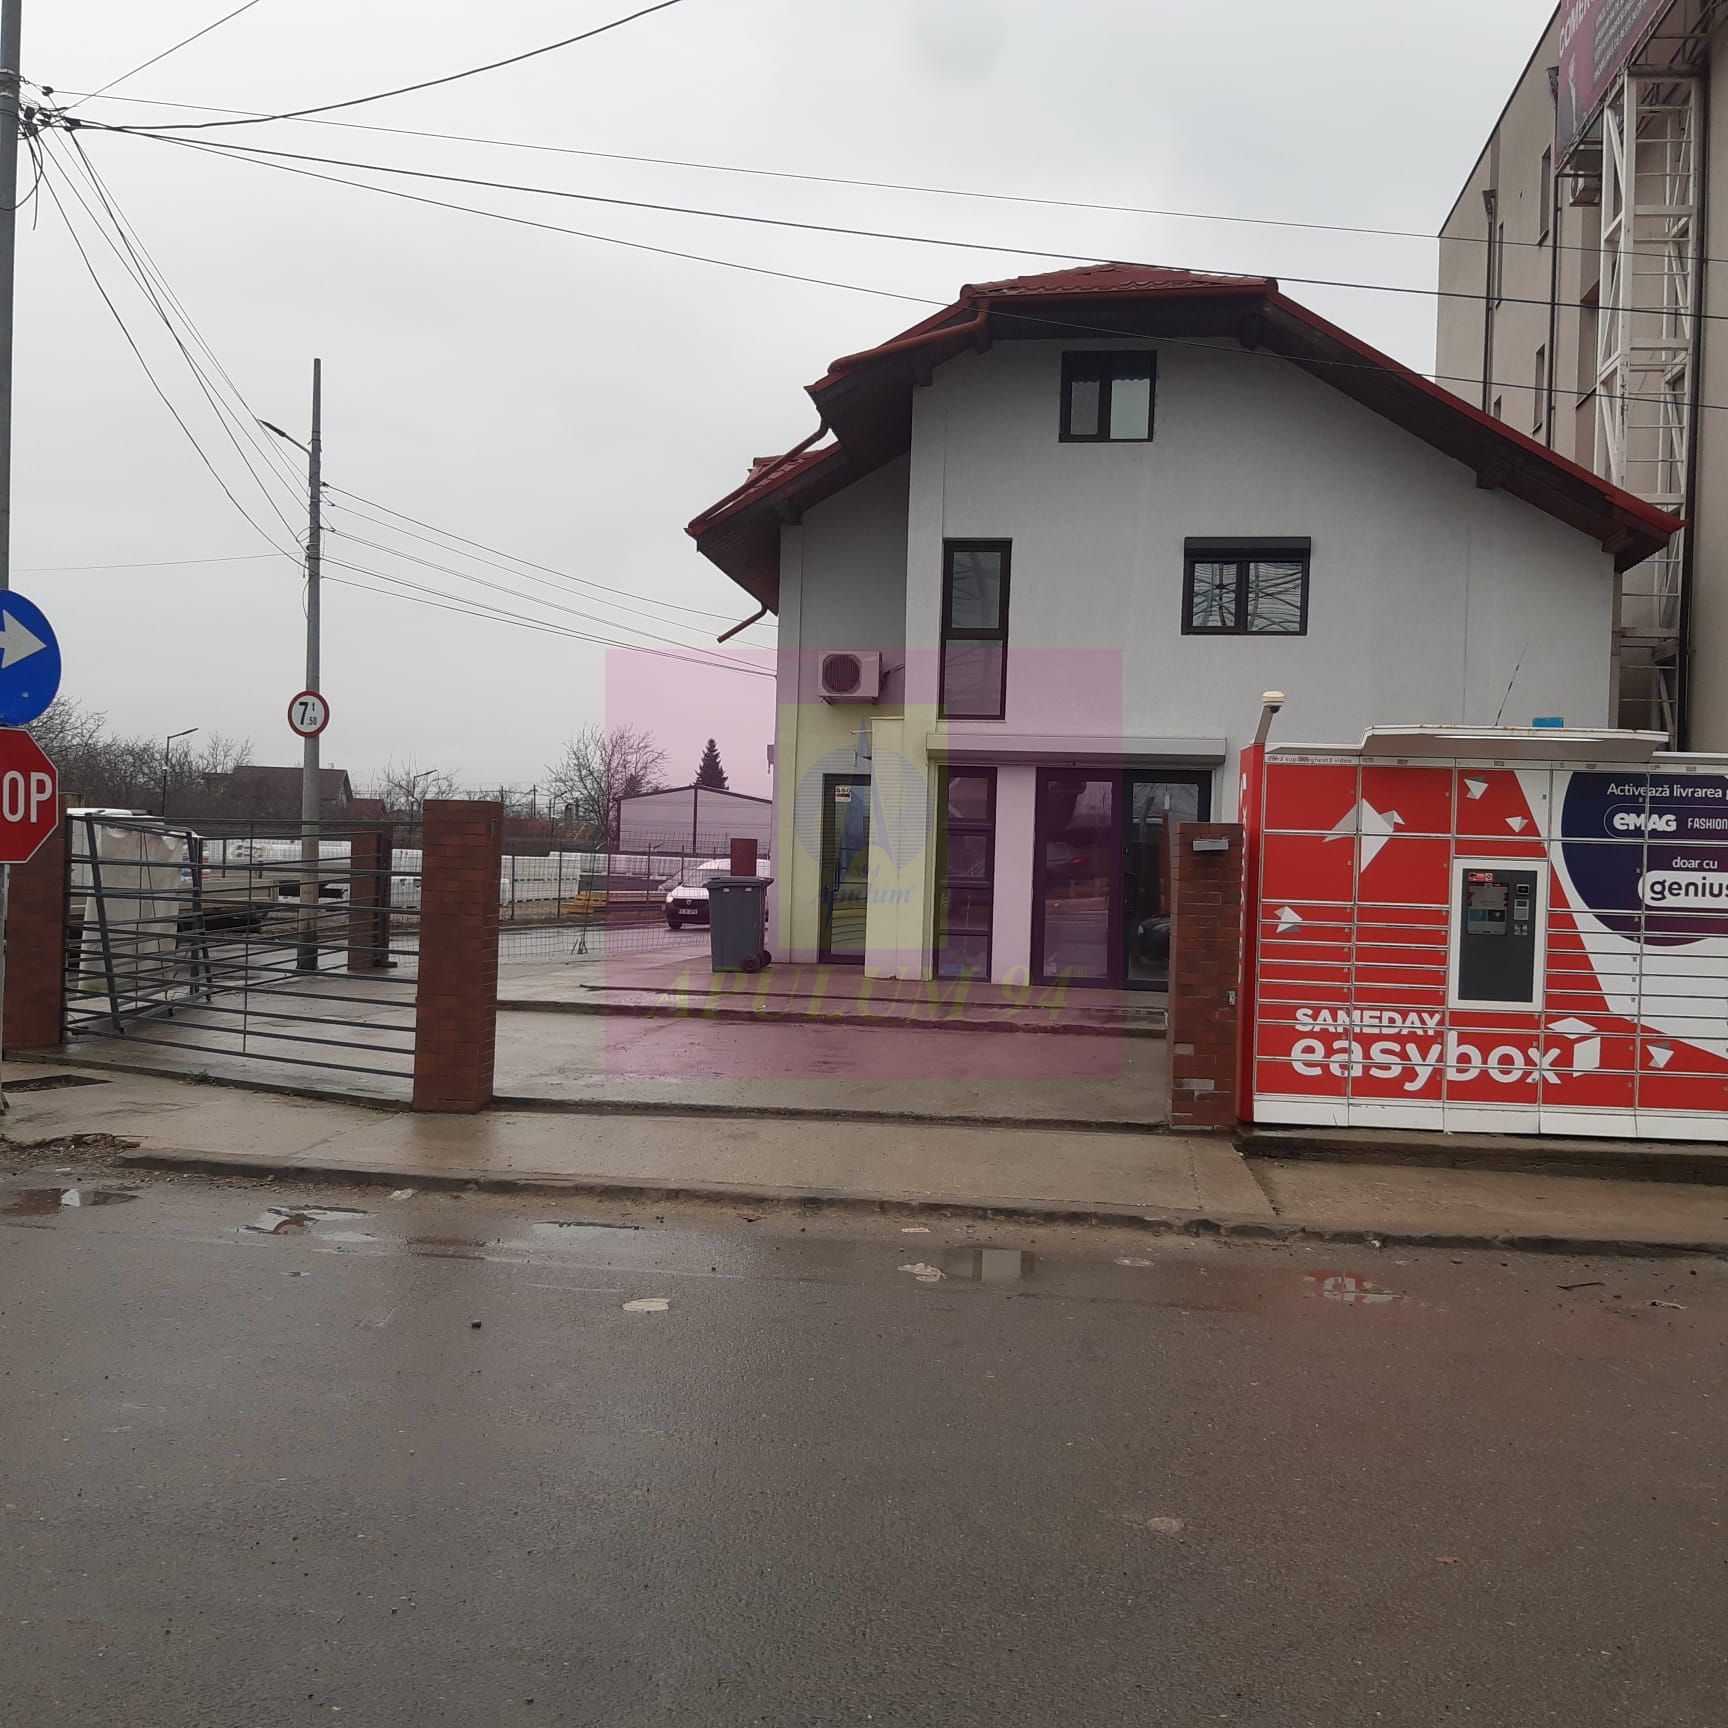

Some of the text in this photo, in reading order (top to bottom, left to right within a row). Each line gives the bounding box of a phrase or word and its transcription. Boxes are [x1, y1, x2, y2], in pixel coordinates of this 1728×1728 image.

[1560, 0, 1594, 58] COMER
[299, 701, 308, 725] 7
[1607, 783, 1670, 797] Activează
[1673, 785, 1722, 798] livrarea
[1613, 812, 1677, 832] eMAG
[1672, 856, 1718, 869] doar cu
[1650, 876, 1728, 901] geniu
[1295, 1008, 1441, 1036] SAMEDAY
[1290, 1030, 1562, 1092] easybox
